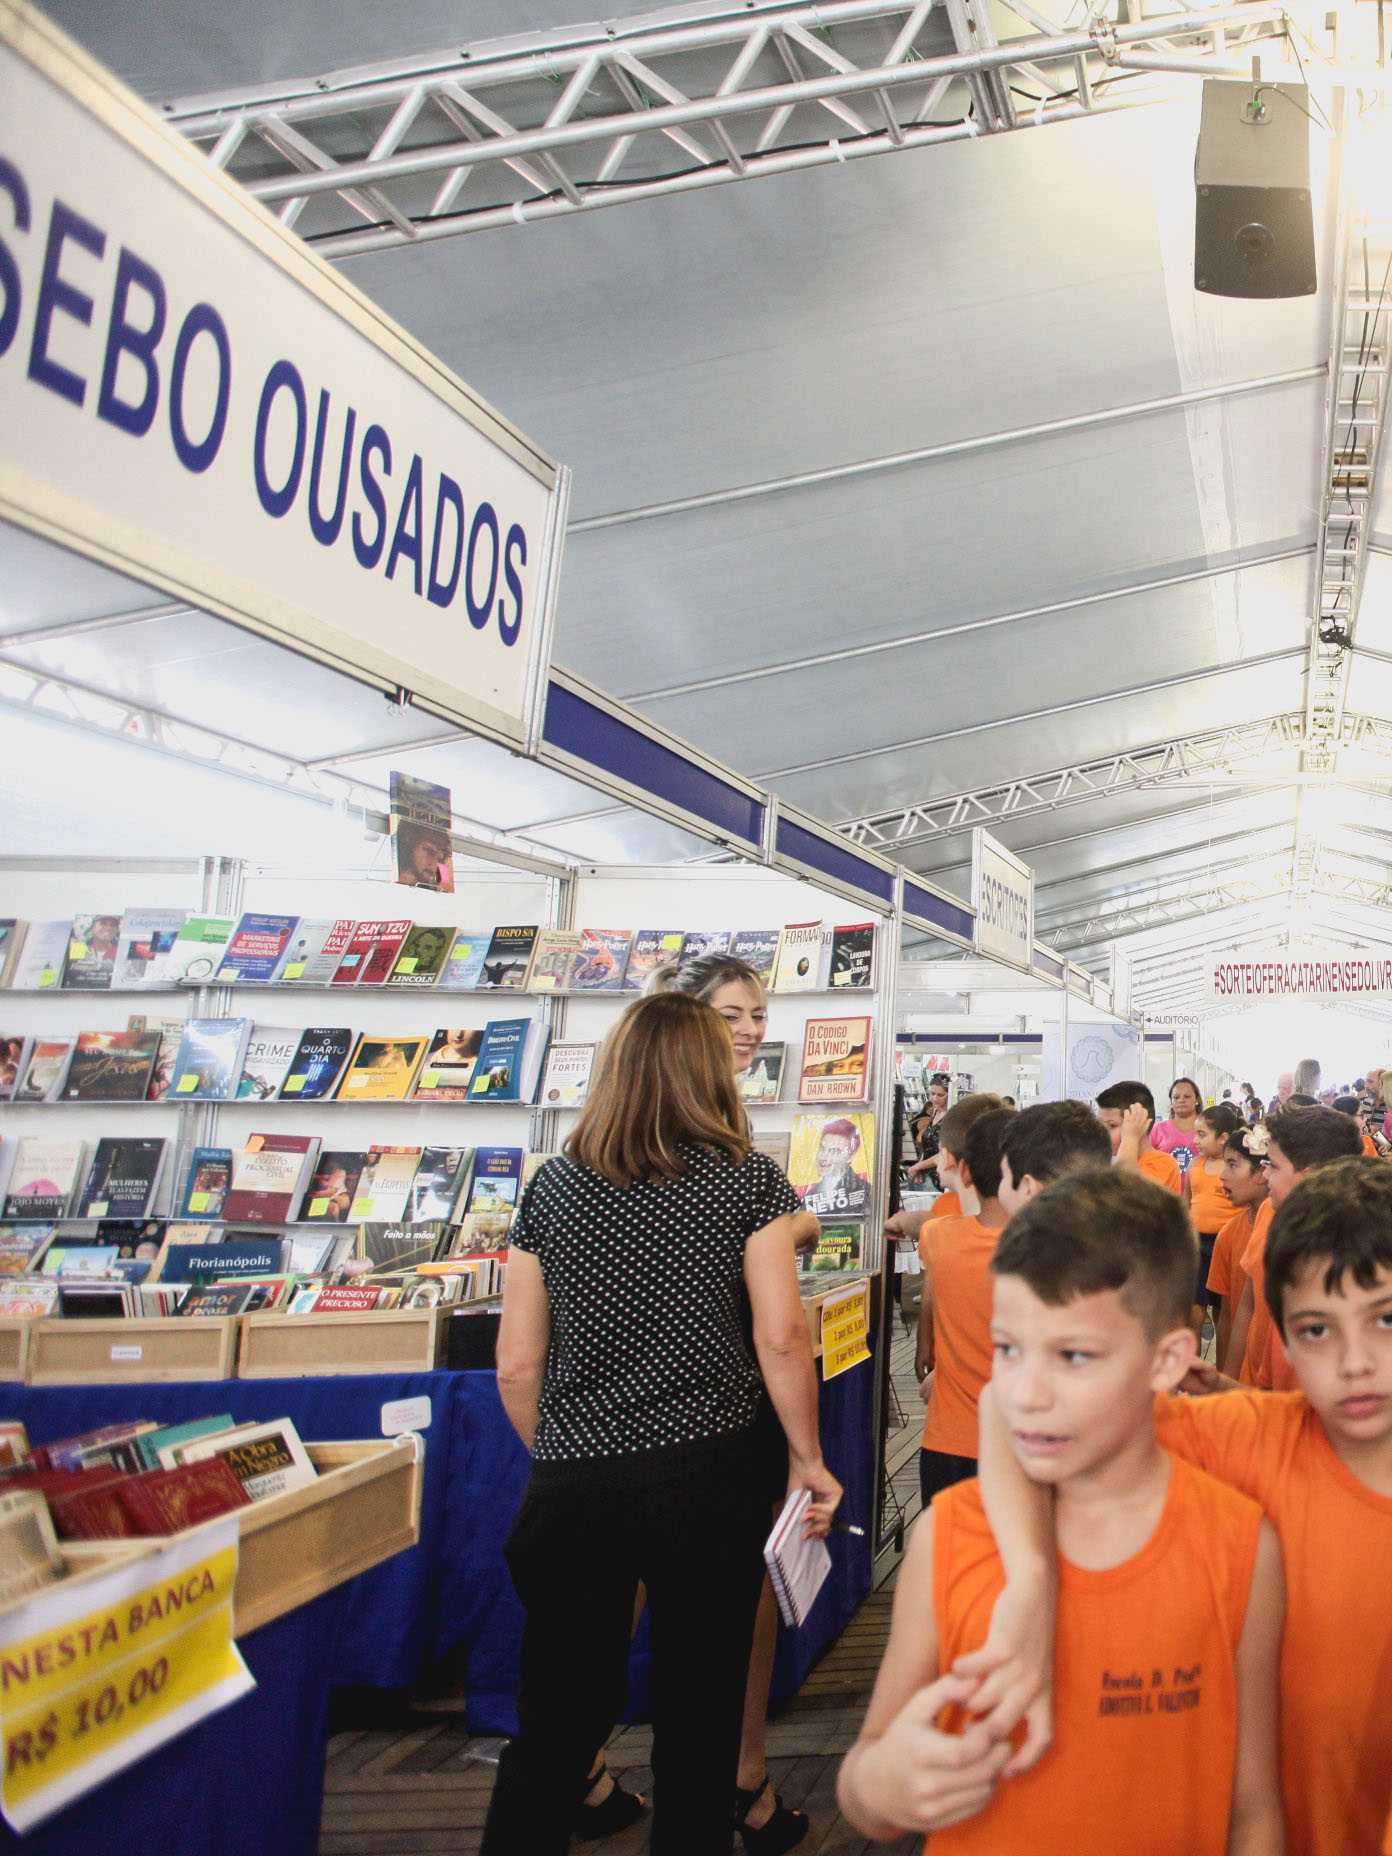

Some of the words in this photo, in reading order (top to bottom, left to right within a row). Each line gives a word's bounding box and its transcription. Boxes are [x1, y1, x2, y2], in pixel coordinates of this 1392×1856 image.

[0, 154, 231, 474] SEBO
[254, 360, 527, 647] OUSADOS
[334, 921, 355, 930] PAI
[357, 923, 381, 935] SUN
[386, 922, 410, 934] TZU
[242, 934, 281, 943] MARKETING
[496, 928, 521, 938] BISPO
[326, 937, 347, 946] PAI
[582, 940, 603, 951] Harry
[603, 939, 628, 951] Potter
[637, 940, 658, 951] Harry
[685, 942, 706, 953] Harry
[706, 941, 729, 953] Potter
[735, 942, 756, 952] Harry
[755, 941, 777, 952] Potter
[850, 950, 871, 960] LAVOURA
[391, 975, 436, 983] LINCOLN
[809, 1026, 816, 1039] O
[323, 1038, 330, 1046] O
[247, 1042, 295, 1058] CRIME
[300, 1045, 346, 1055] QUARTO
[807, 1041, 821, 1056] DA
[823, 1040, 849, 1056] VINCI
[246, 1057, 291, 1065] RGANIZADO
[309, 1055, 329, 1063] DIA
[552, 1064, 587, 1072] FORTES
[807, 1083, 824, 1096] DAN
[827, 1082, 857, 1095] BROWN
[805, 1187, 847, 1205] FELIPE
[805, 1196, 849, 1215] NETO
[383, 1229, 402, 1239] Feito
[413, 1230, 436, 1239] mãos
[818, 1236, 852, 1245] Lavoura
[816, 1244, 852, 1254] dourada
[189, 1255, 272, 1269] Florianópolis
[331, 1289, 379, 1299] PRESENTE
[320, 1299, 368, 1308] PRECIOSO
[229, 1449, 243, 1465] A
[241, 1442, 277, 1461] Obra
[247, 1452, 290, 1474] Negro
[1, 1617, 120, 1692] NESTA
[128, 1569, 216, 1637] BANCA
[5, 1710, 59, 1776] R$
[72, 1655, 170, 1741] 10,00
